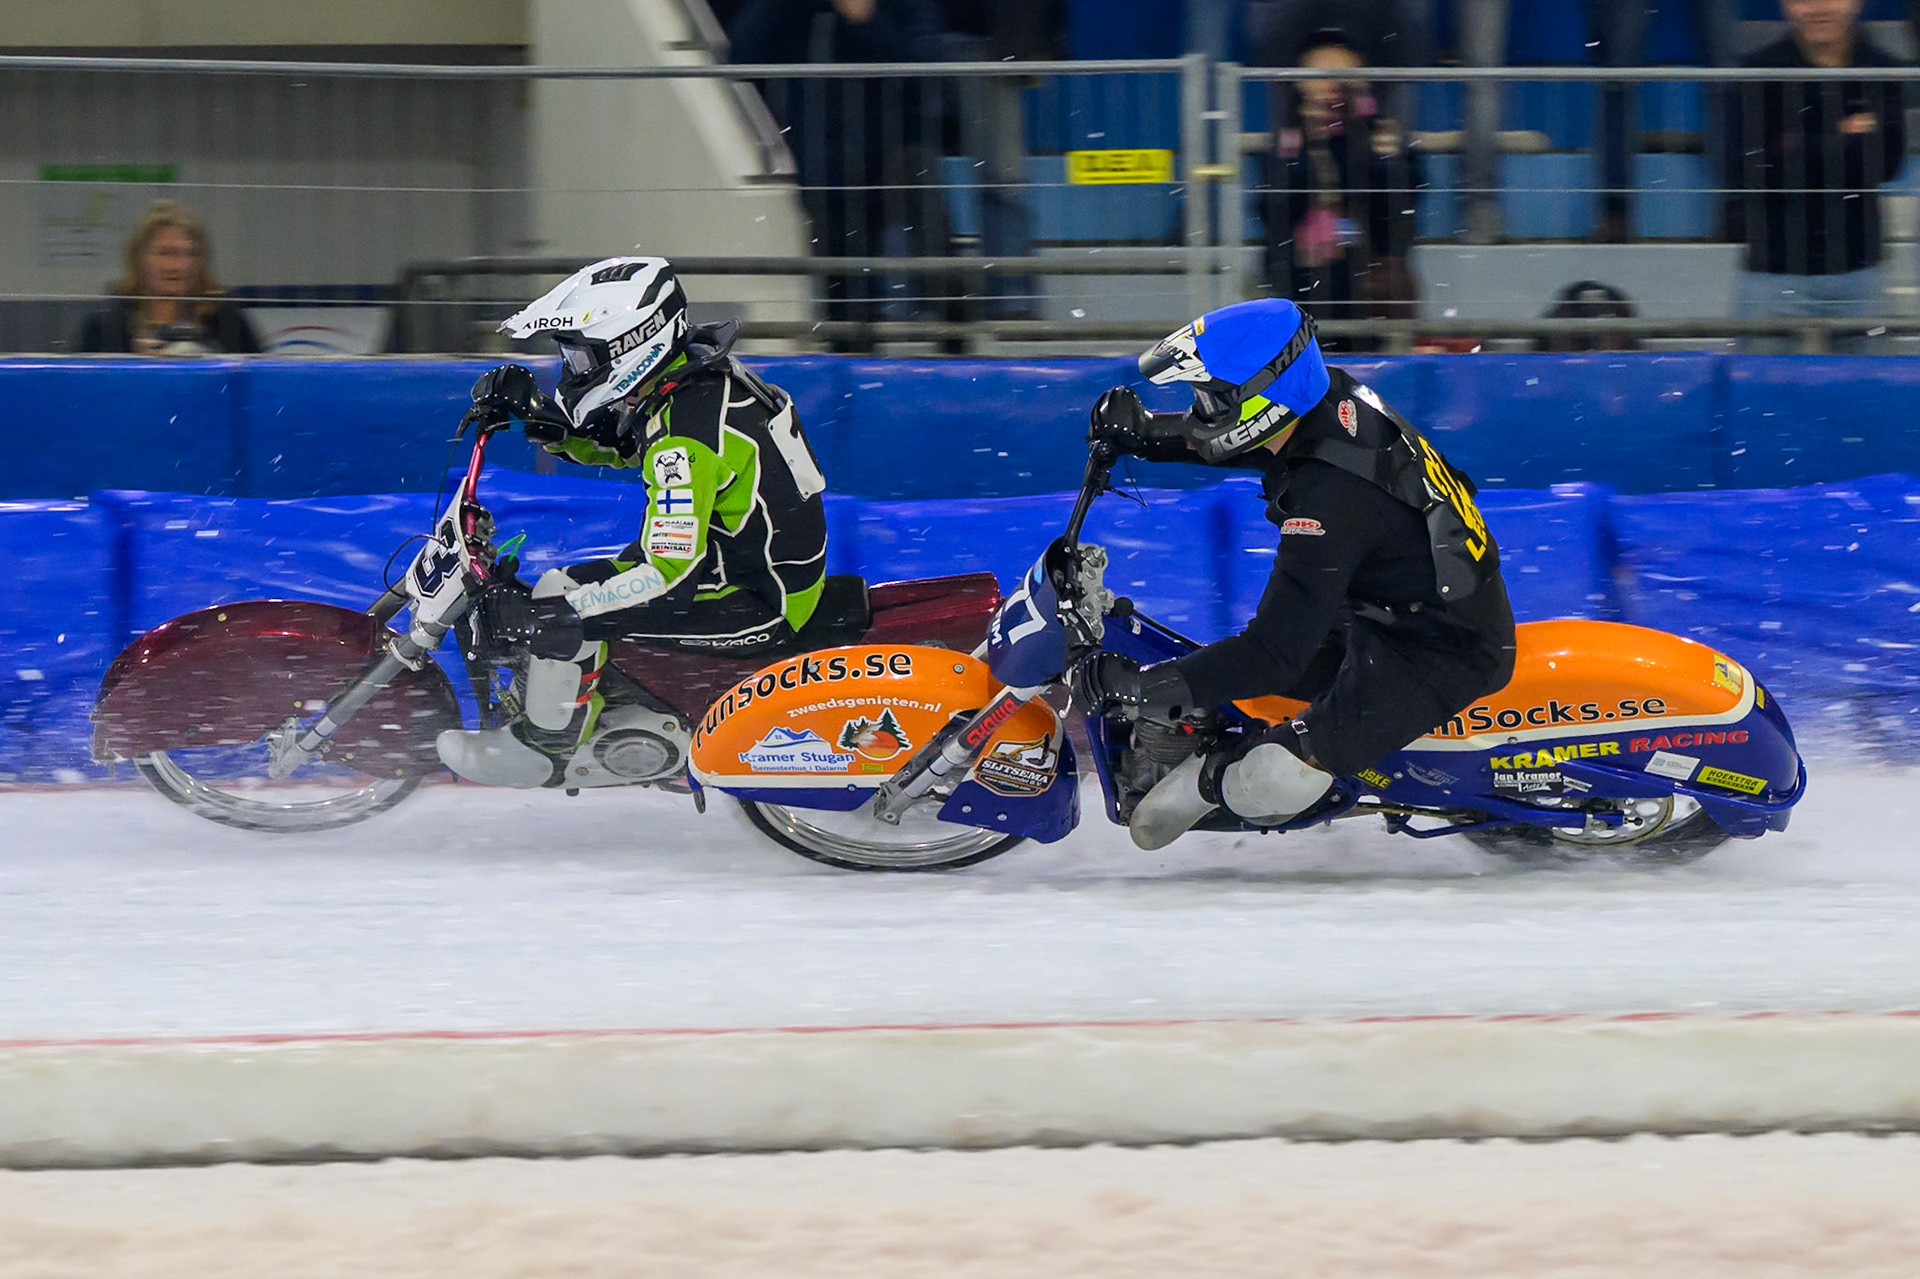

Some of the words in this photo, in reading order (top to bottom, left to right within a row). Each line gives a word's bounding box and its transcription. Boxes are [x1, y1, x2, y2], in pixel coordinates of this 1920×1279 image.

[522, 316, 573, 330] AIROH
[608, 309, 667, 359] RAVEN
[1210, 402, 1291, 450] KENN
[569, 571, 661, 609] TEMACON
[695, 652, 912, 750] runSocks.se
[786, 695, 942, 718] zweedsgenieten.nl
[1428, 697, 1666, 736] nSocks.se
[966, 698, 1019, 746] SHOWA
[739, 752, 796, 763] Kramer
[800, 751, 855, 764] Stugan
[1490, 741, 1621, 770] KRAMER
[1629, 730, 1749, 753] RACING
[981, 760, 1049, 784] SIJTSEMA
[1494, 771, 1514, 781] Jan
[1516, 771, 1561, 781] Kramer
[1708, 770, 1759, 787] HOEKSTRA
